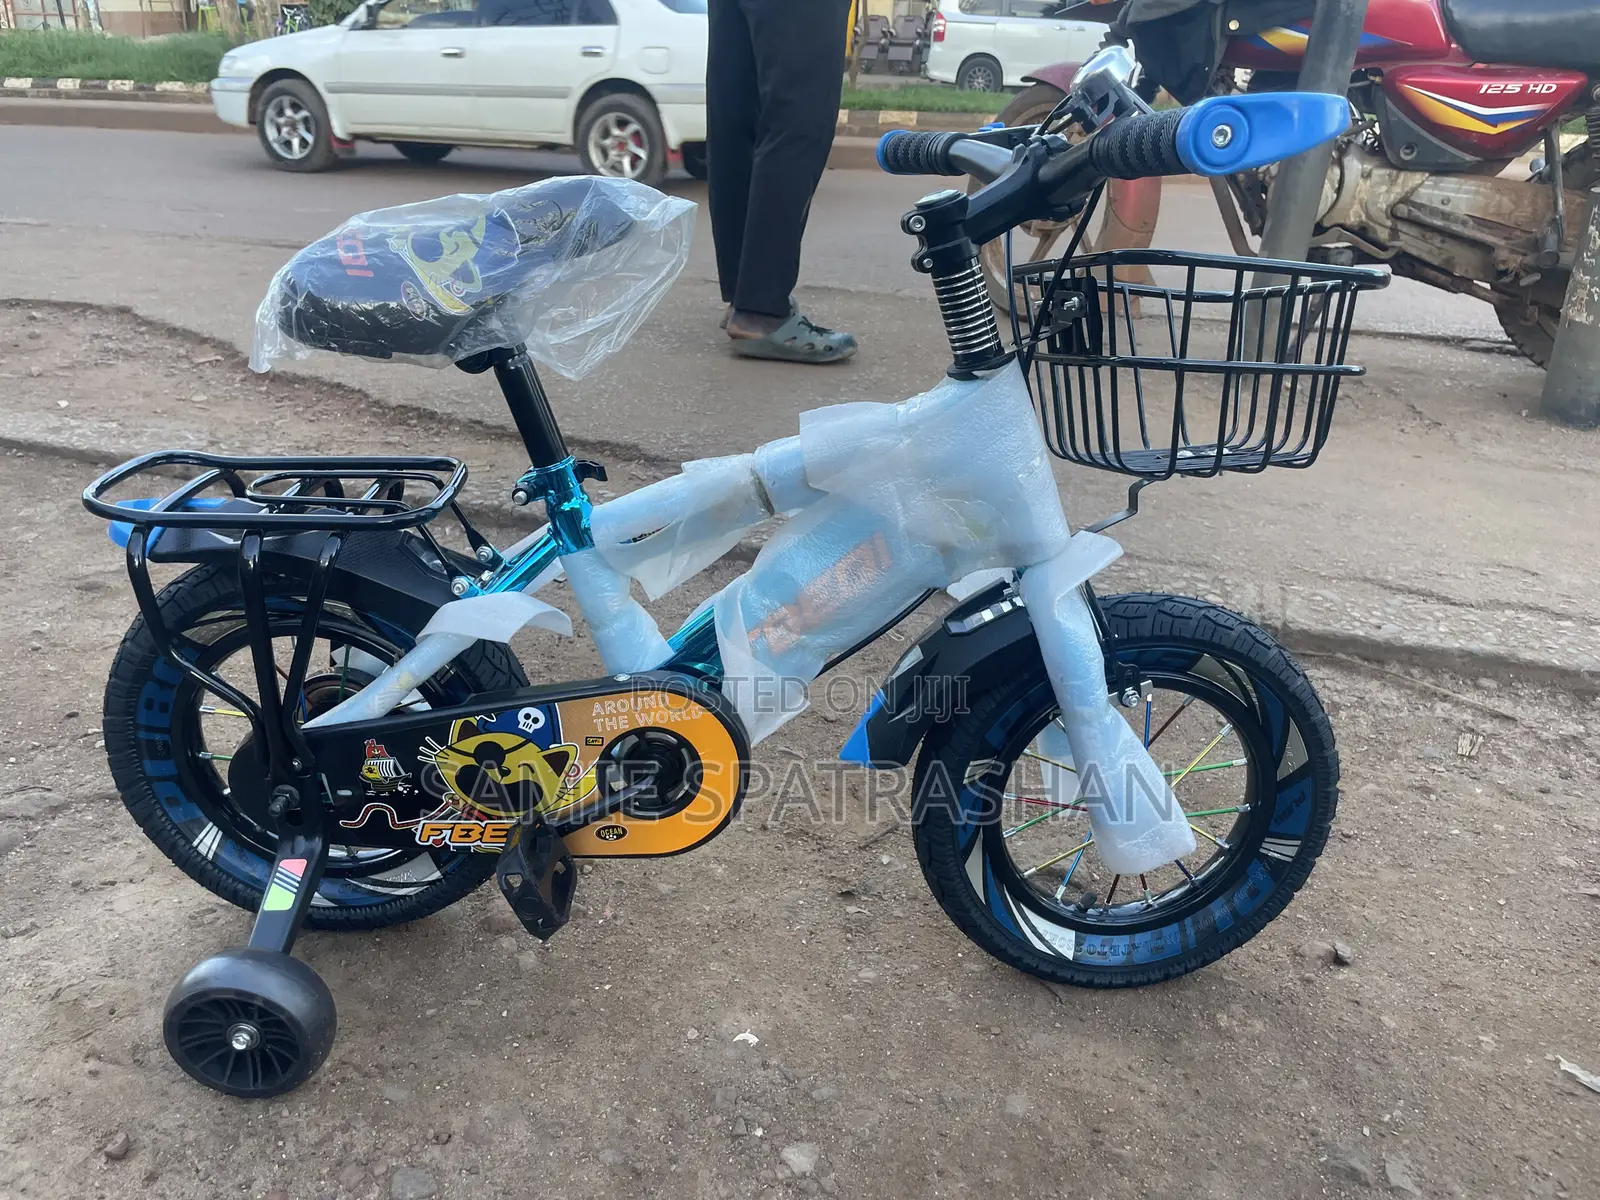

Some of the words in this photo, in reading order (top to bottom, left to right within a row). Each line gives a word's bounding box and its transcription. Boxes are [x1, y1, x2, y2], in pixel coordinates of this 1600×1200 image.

[1479, 83, 1523, 94] 125
[1527, 83, 1557, 94] HD
[592, 694, 670, 716] AROUND
[593, 715, 630, 732] THE
[635, 705, 703, 727] WORLD
[600, 827, 624, 838] OCEAN
